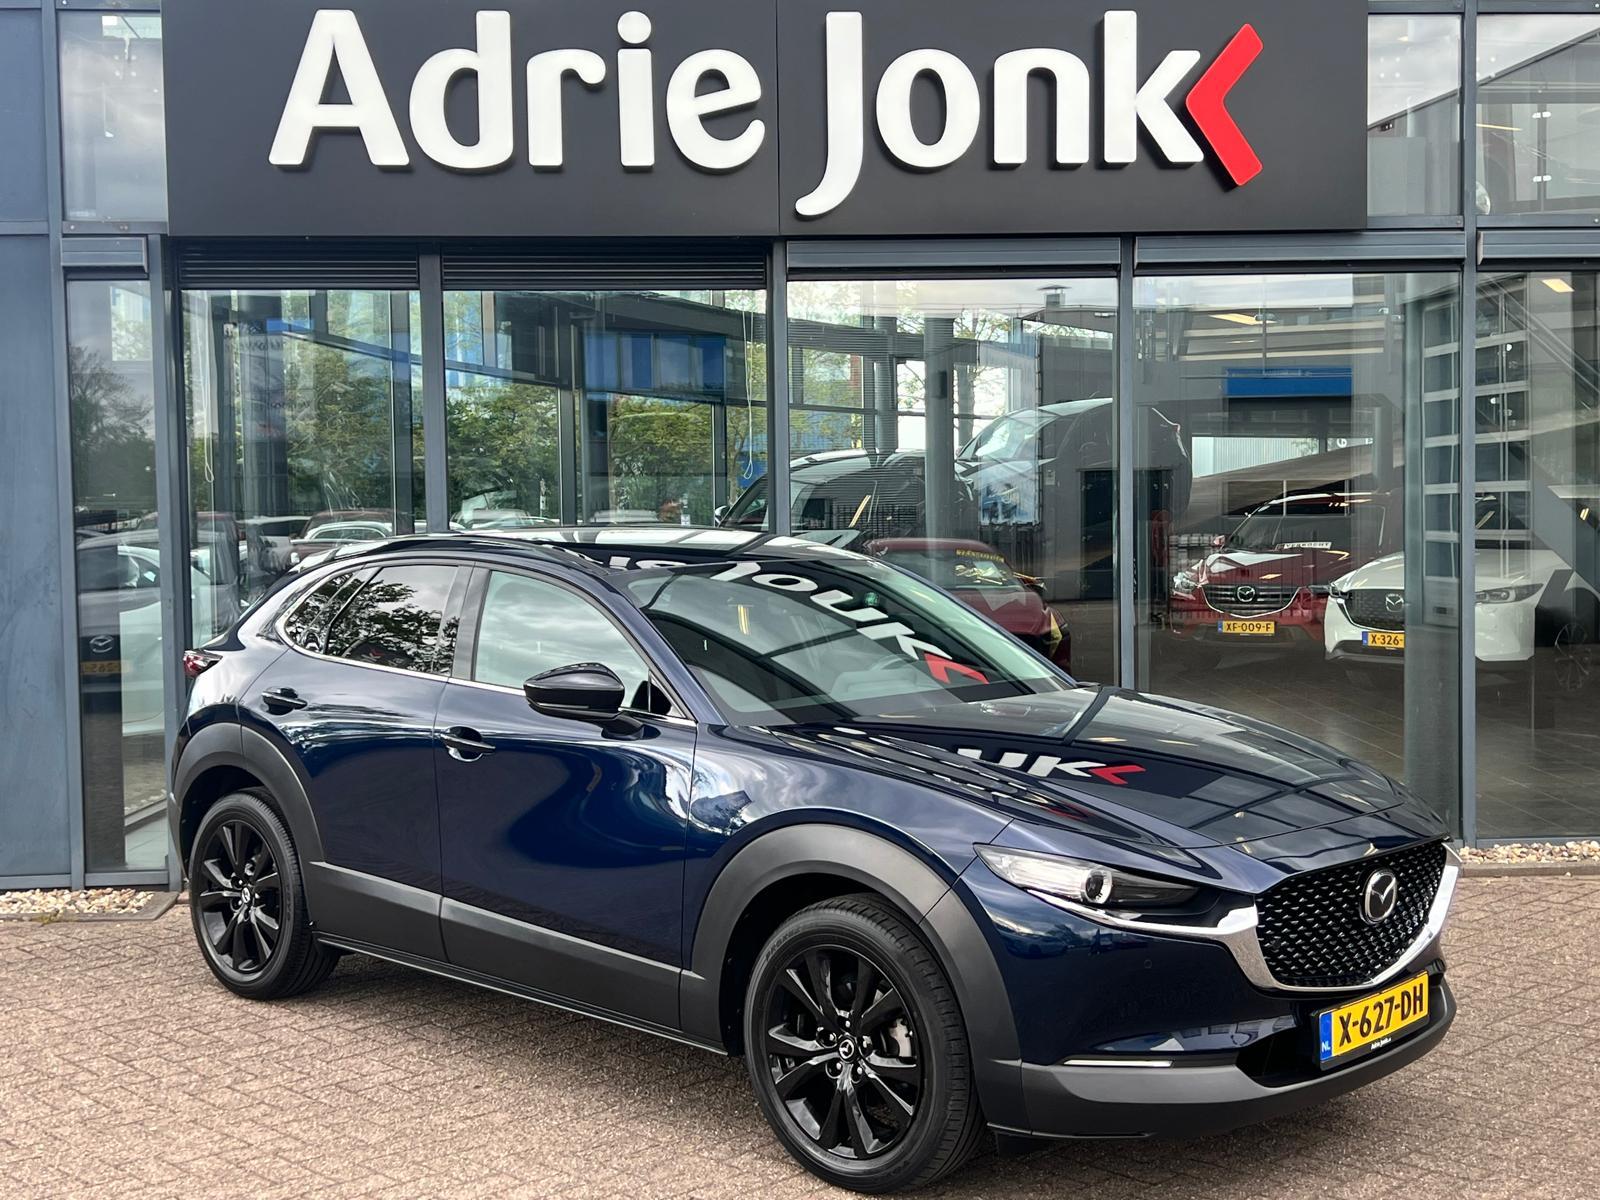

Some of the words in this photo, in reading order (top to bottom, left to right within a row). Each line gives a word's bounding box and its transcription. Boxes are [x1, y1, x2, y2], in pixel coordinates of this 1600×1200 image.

[268, 9, 767, 170] Adrie
[795, 10, 1204, 217] Jonk
[1226, 622, 1272, 632] XF-009-F
[1371, 634, 1403, 646] X-326-
[1338, 983, 1424, 1048] X-627-DH
[1321, 1041, 1331, 1053] NL
